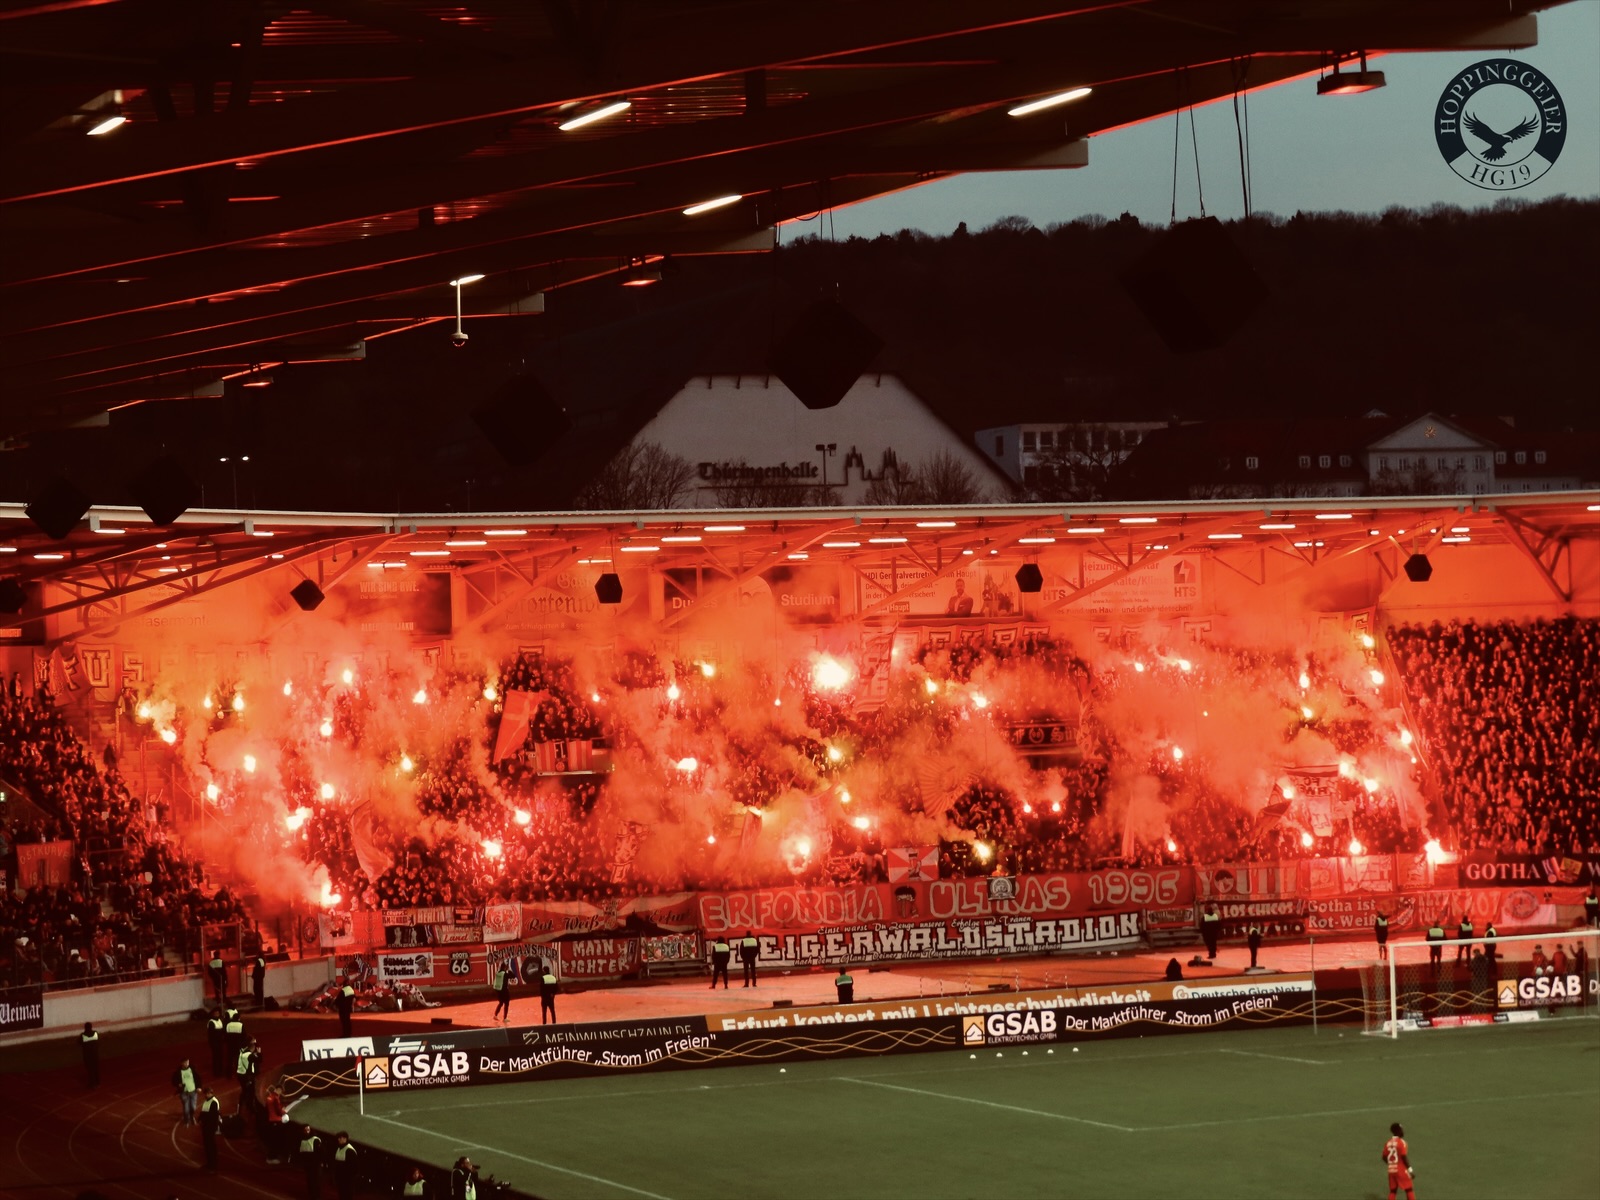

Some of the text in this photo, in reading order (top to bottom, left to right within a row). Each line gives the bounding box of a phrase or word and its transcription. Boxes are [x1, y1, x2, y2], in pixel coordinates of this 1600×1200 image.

[698, 461, 819, 480] Thüringenhalle
[781, 593, 835, 607] Studium
[1174, 586, 1197, 597] HTS
[1466, 862, 1541, 880] GOTHA
[699, 886, 883, 932] ERFORDIA
[1088, 871, 1181, 905] 1996
[1223, 902, 1293, 918] LOS CHICOS
[1308, 896, 1376, 912] Gotha ist
[563, 914, 600, 931] Weiß
[572, 938, 614, 957] MAIN
[452, 959, 470, 974] 66
[1518, 974, 1582, 999] GSAB
[722, 1014, 788, 1031] Erfurt
[881, 1006, 917, 1020] mit
[987, 1010, 1057, 1036] GSAB
[1065, 1015, 1090, 1031] Der
[1091, 1005, 1167, 1031] Marktführer
[1215, 1007, 1231, 1022] im
[545, 1023, 692, 1043] MEINWUNSCHZAUNDE
[987, 1034, 1039, 1044] ELEKTROTECHNIK
[391, 1051, 470, 1079] GSAB
[479, 1055, 505, 1071] Der
[508, 1045, 593, 1072] Marktführer
[645, 1044, 663, 1063] im
[392, 1074, 470, 1087] ELEKTROTECHNIK GMBH
